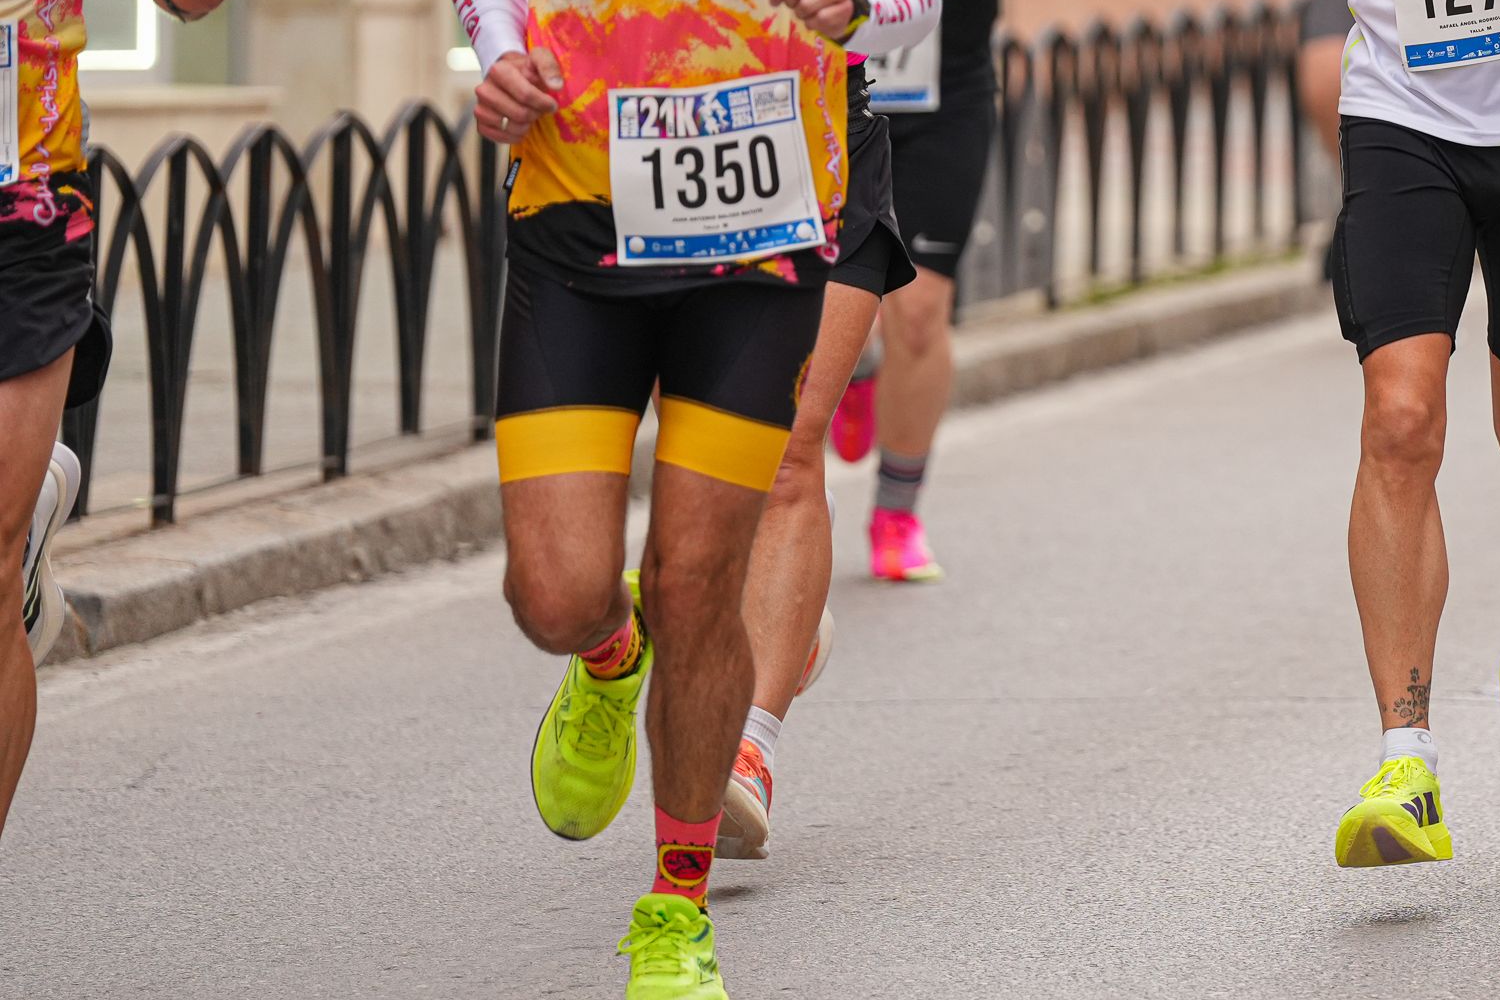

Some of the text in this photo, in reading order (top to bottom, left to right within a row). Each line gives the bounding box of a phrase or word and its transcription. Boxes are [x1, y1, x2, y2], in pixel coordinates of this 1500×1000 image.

[1439, 22, 1459, 30] RAFAEL
[639, 96, 700, 138] 21K
[641, 134, 780, 210] 1350
